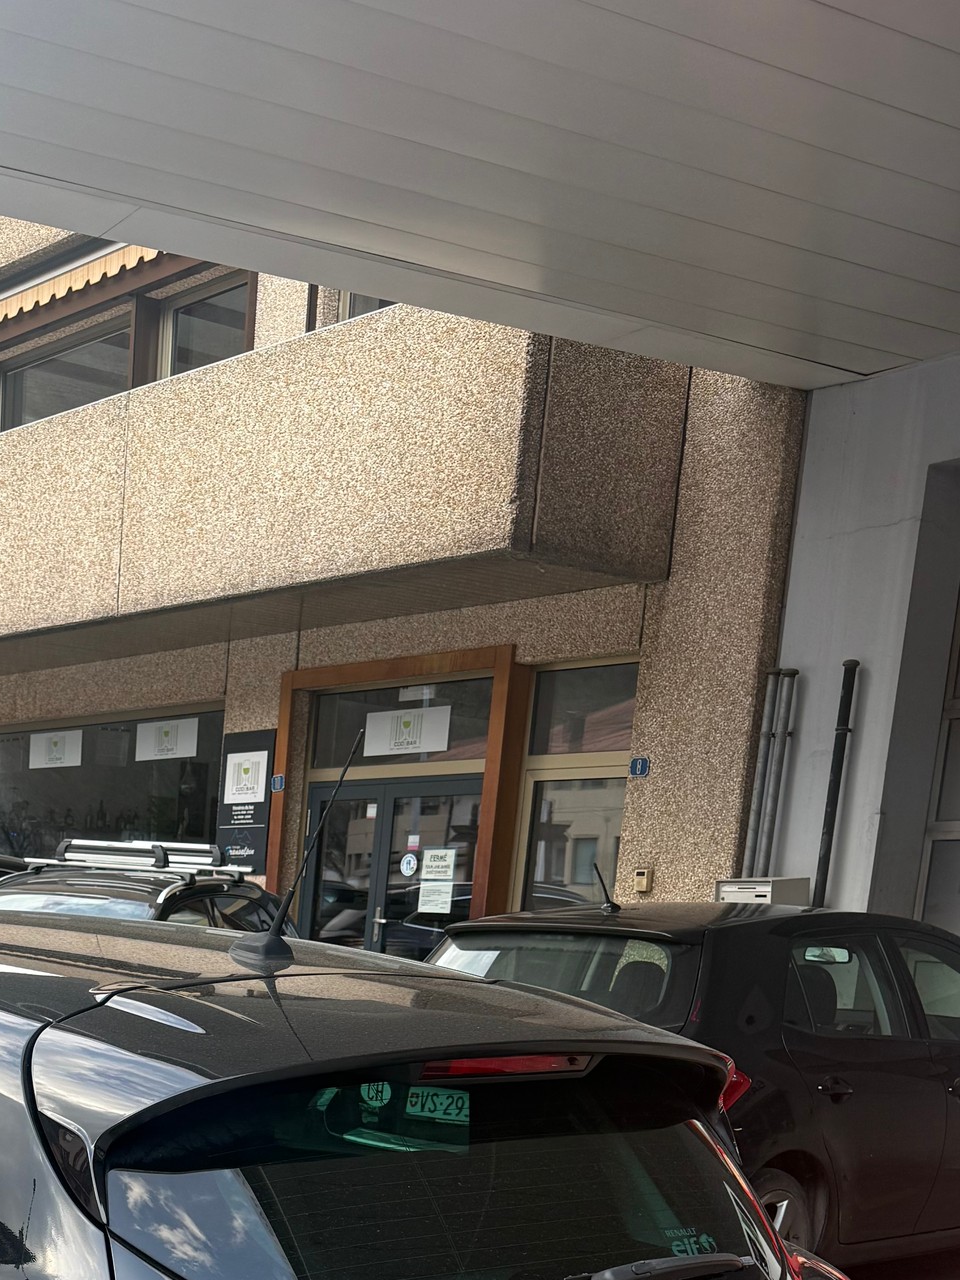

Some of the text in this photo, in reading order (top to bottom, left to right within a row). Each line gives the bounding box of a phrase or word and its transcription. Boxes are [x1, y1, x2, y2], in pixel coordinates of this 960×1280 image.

[367, 1083, 385, 1101] CH
[664, 1227, 696, 1238] RENAULT
[671, 1237, 699, 1257] elf
